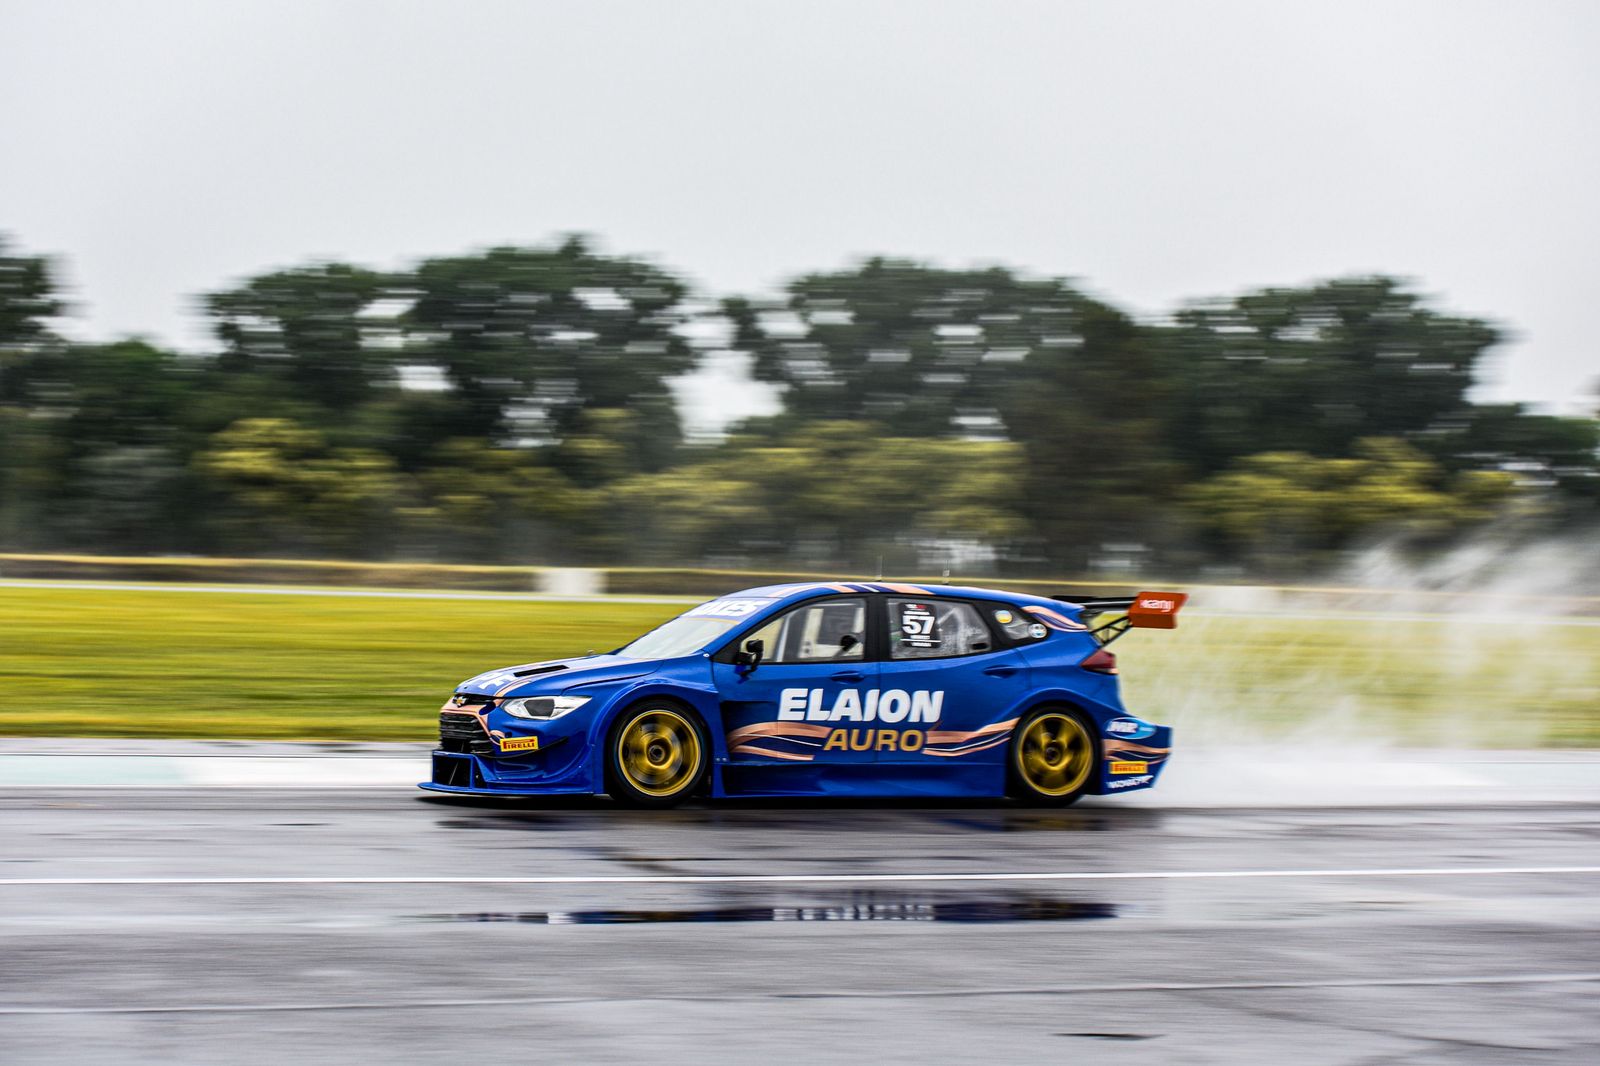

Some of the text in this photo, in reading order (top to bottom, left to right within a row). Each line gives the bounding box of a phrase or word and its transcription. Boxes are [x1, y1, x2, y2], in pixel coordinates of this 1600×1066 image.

[902, 615, 936, 635] 57
[777, 687, 945, 724] ELAION
[502, 738, 536, 751] PIRELLI
[823, 729, 924, 752] AURO
